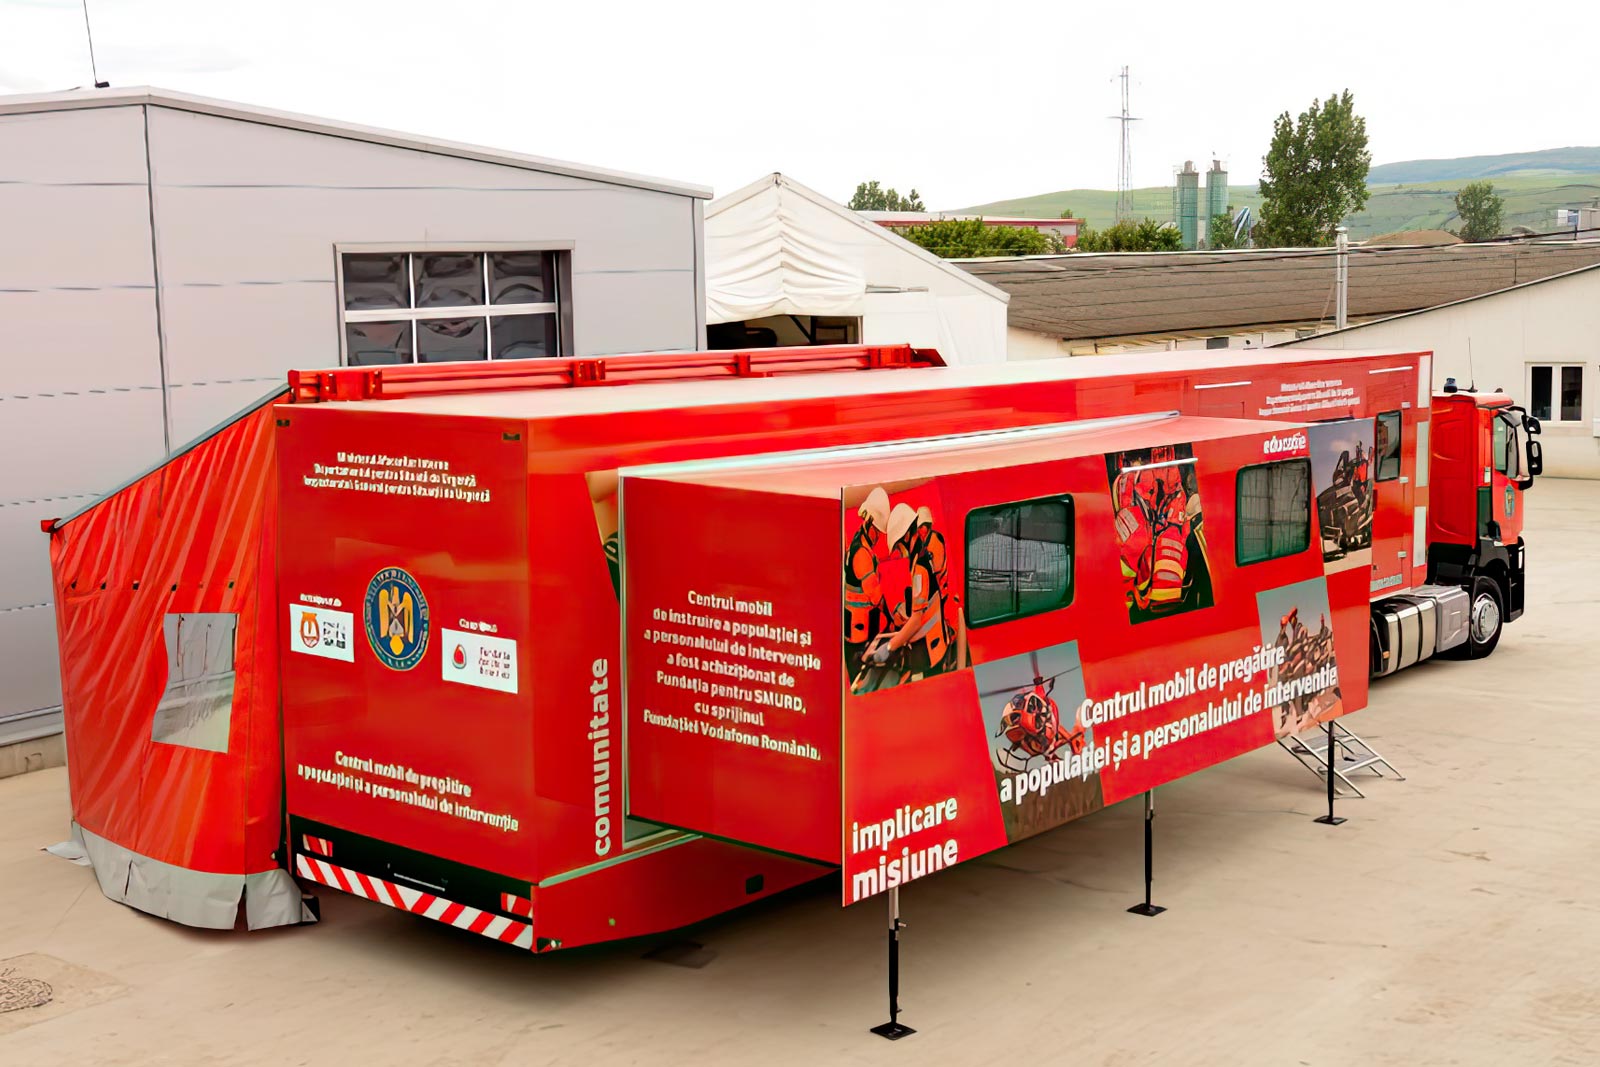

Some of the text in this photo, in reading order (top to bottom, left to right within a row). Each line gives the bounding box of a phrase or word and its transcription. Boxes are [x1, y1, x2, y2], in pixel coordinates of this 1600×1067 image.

[688, 591, 772, 616] Centrul mobil
[653, 608, 667, 621] de
[669, 609, 721, 630] instruire
[723, 621, 730, 631] a
[644, 629, 651, 639] a
[653, 630, 728, 653] personalului
[730, 642, 745, 656] de
[666, 654, 674, 664] a
[676, 653, 699, 669] fost
[778, 673, 794, 687] de
[711, 683, 752, 701] pentru
[1080, 644, 1285, 728] Centrul mobil de pregătire
[694, 702, 765, 726] cu sprijinul
[700, 722, 759, 746] Vodafone
[1001, 778, 1012, 802] a
[1113, 732, 1127, 770] și
[1130, 734, 1141, 755] a
[1144, 696, 1242, 760] personalului
[1244, 688, 1261, 715] de
[335, 751, 372, 773] Centrul
[588, 658, 611, 857] comunitate
[853, 797, 958, 853] implicare
[853, 839, 958, 902] misiune
